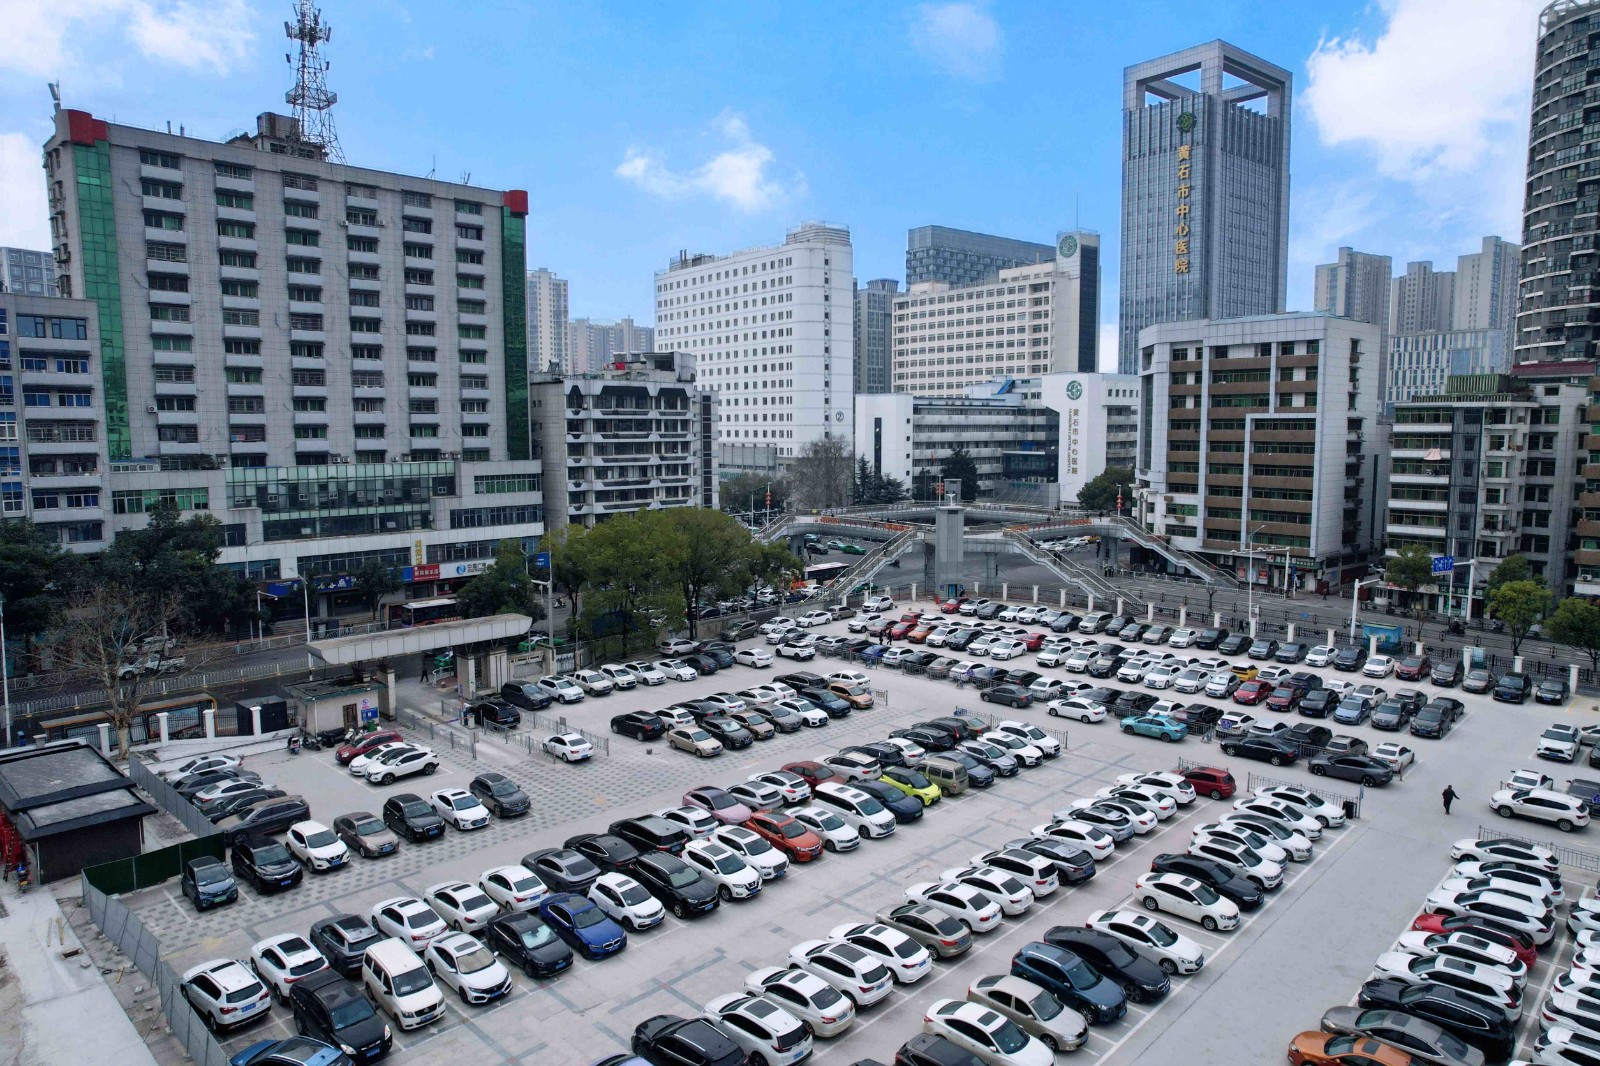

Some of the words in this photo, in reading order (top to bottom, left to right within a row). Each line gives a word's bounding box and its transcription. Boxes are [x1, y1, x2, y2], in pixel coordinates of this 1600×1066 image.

[1175, 145, 1191, 274] 黄石市中心医院
[1071, 408, 1079, 475] 黄石市中心医院
